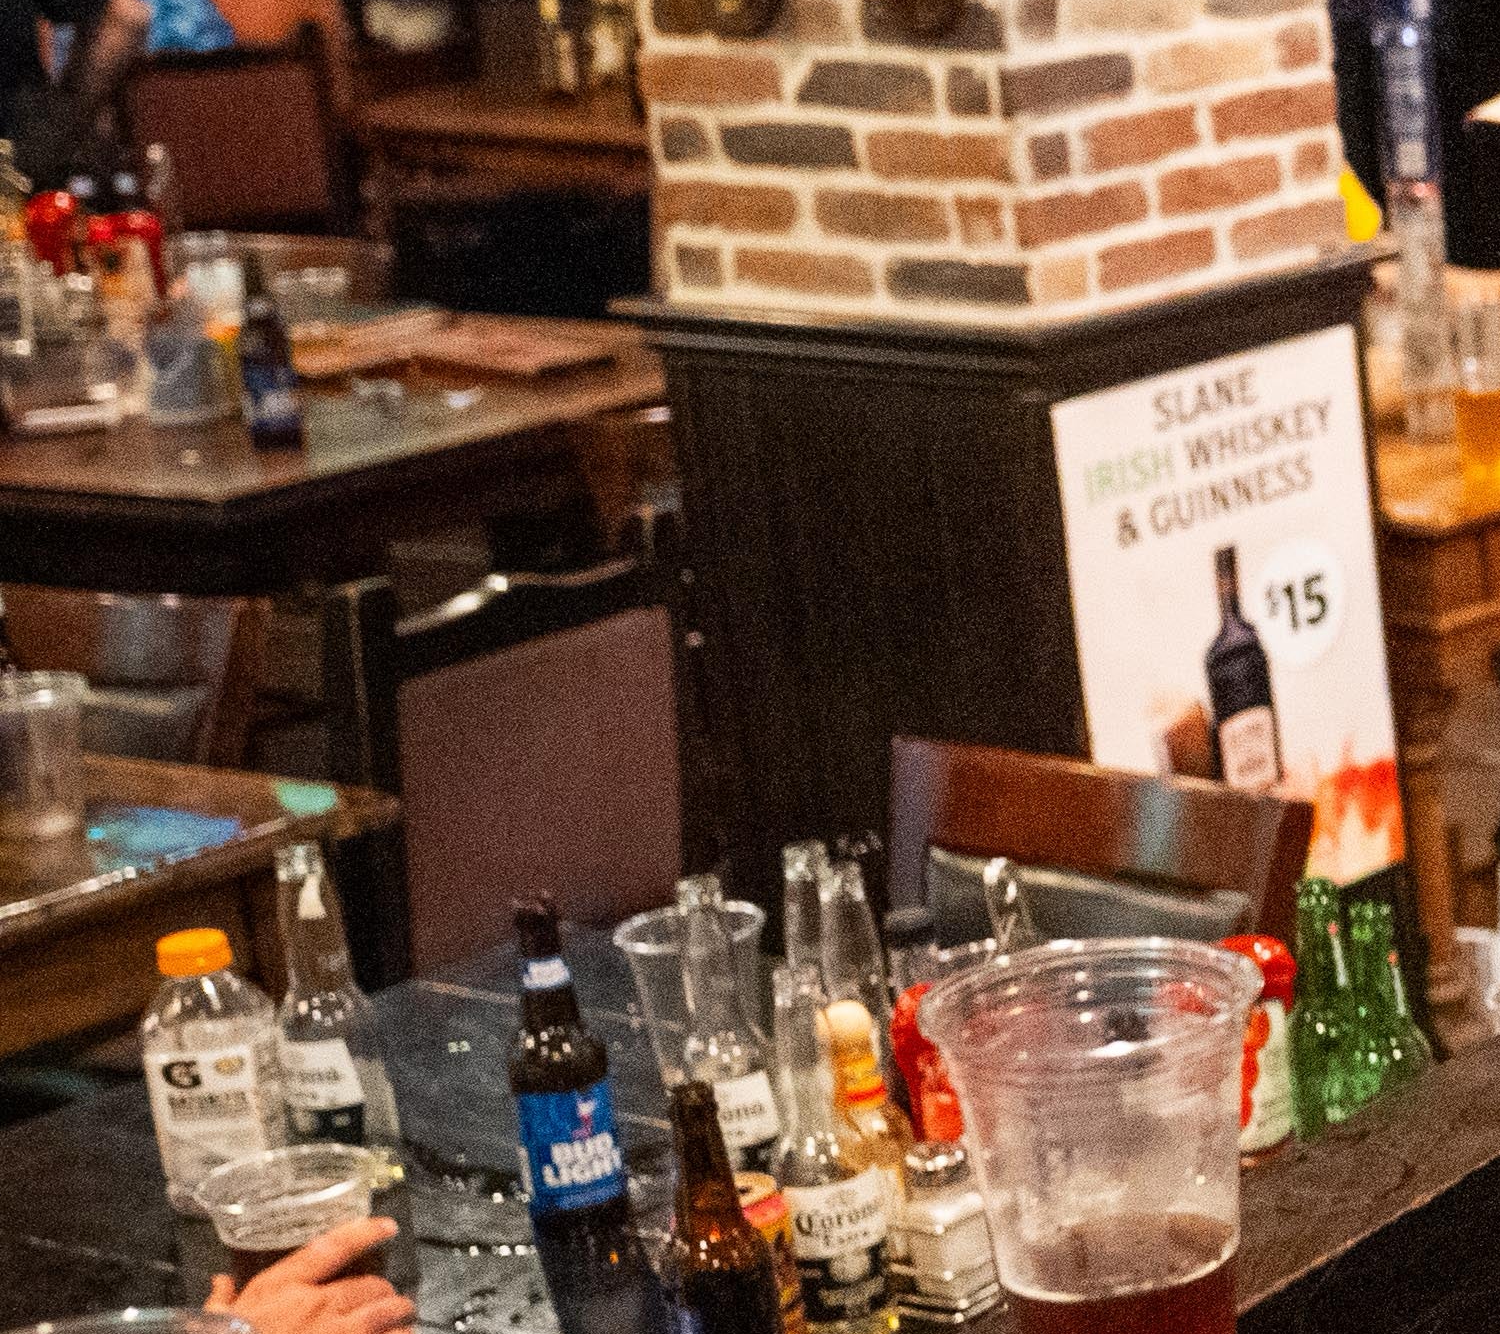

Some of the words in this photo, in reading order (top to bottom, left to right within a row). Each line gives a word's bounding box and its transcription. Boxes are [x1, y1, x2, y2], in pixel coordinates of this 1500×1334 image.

[1151, 366, 1258, 433] SLANE
[1084, 444, 1174, 504] IRISH
[1183, 399, 1332, 470] WHISKEY
[1116, 505, 1141, 549] &
[1148, 453, 1314, 536] GUINNESS
[1265, 573, 1328, 632] $15
[542, 1147, 622, 1189] LIGHT
[550, 1131, 613, 1168] BUD
